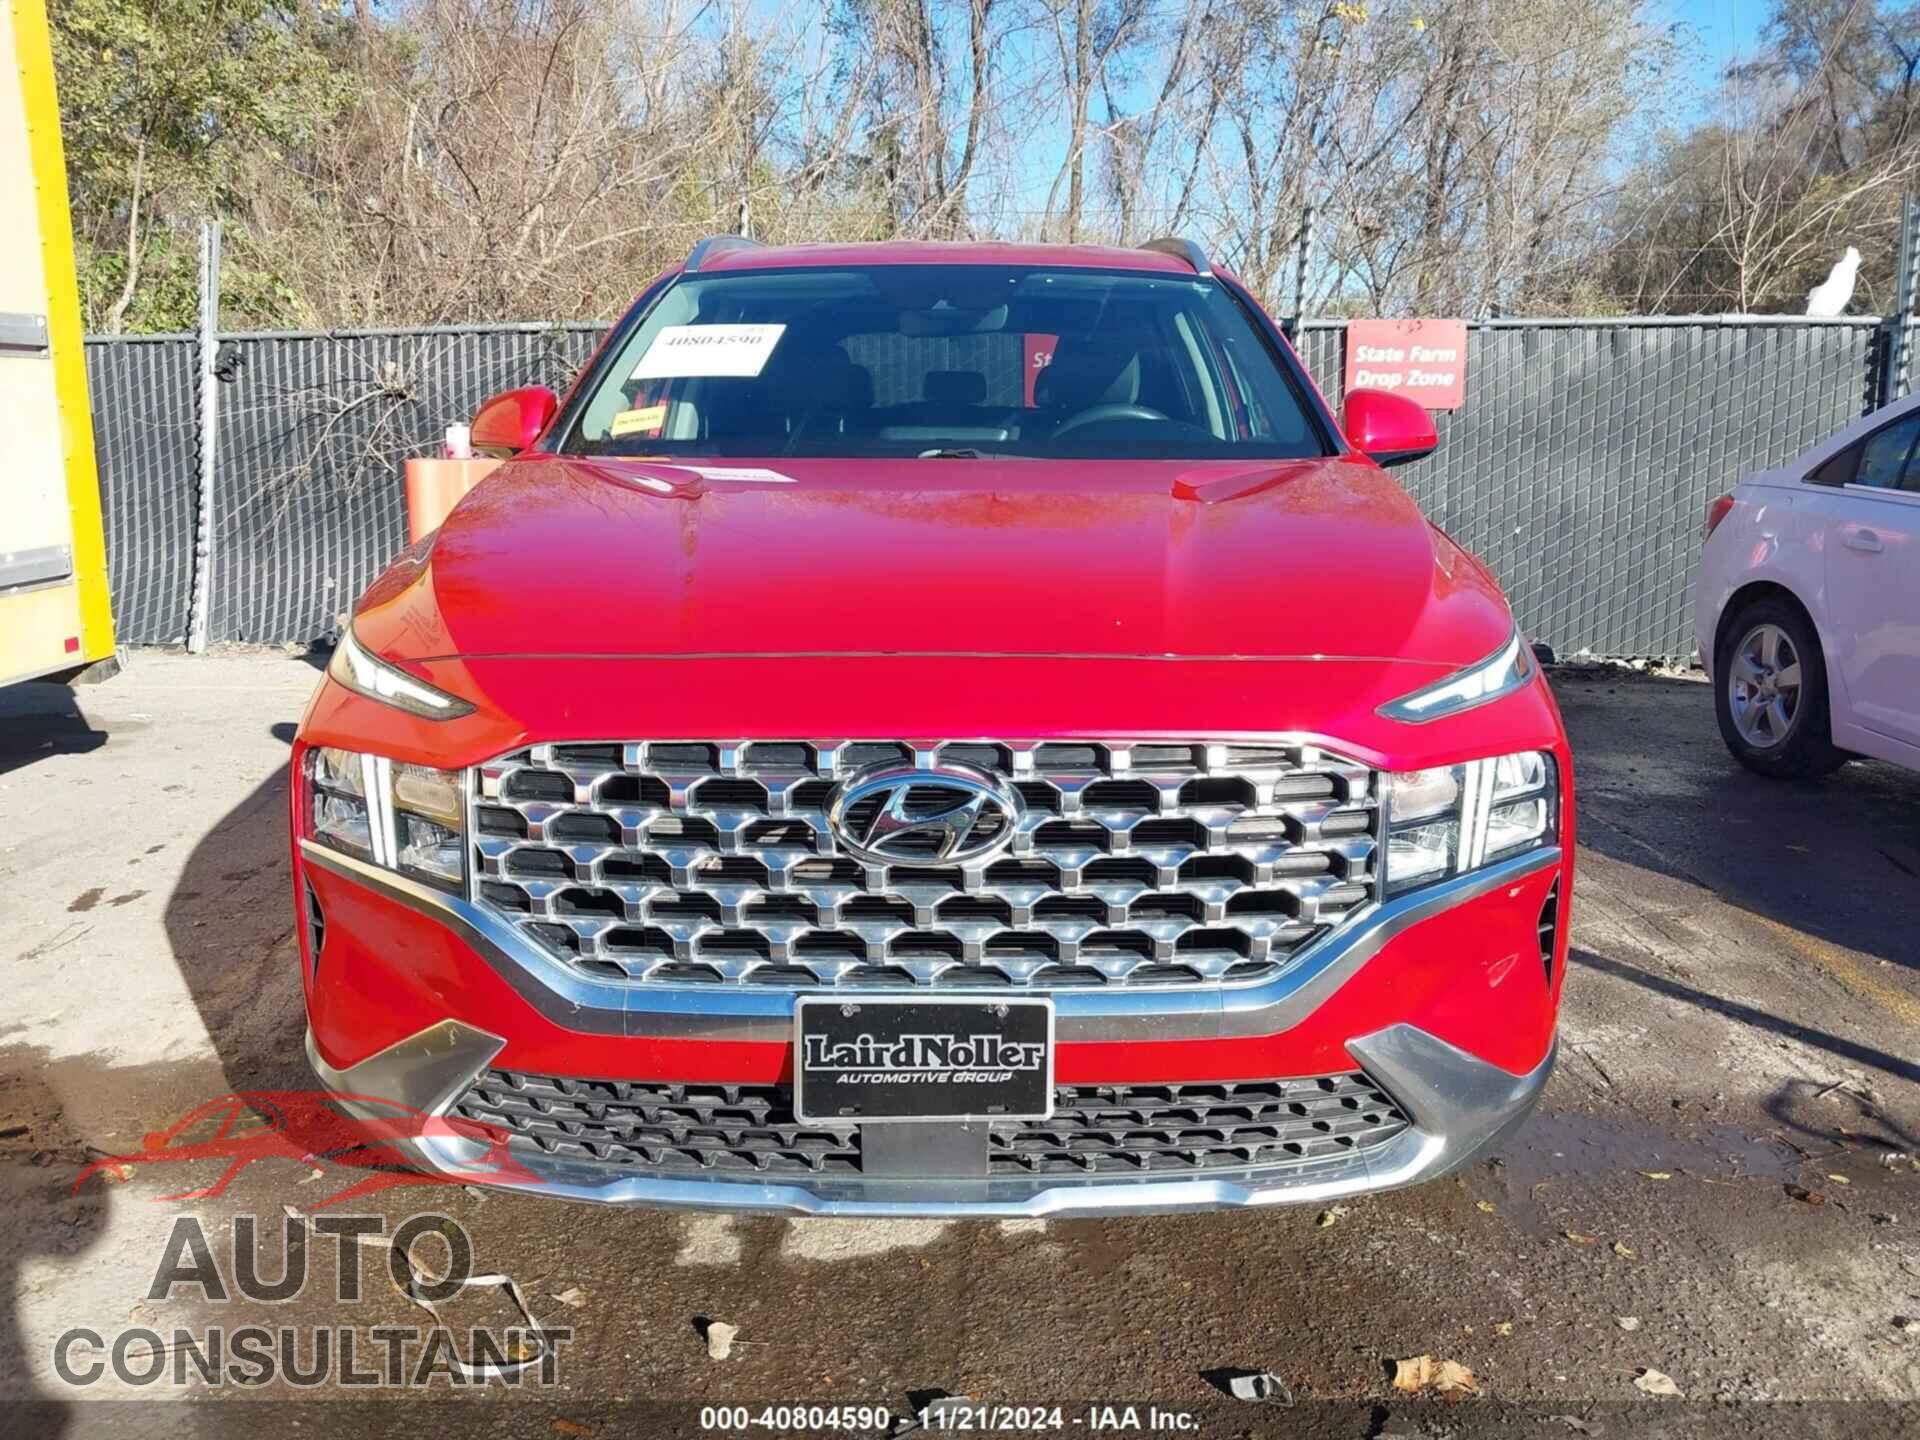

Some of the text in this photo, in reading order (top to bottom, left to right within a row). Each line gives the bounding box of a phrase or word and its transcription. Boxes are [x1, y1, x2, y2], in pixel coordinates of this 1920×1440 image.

[1355, 346, 1456, 362] State Farm
[1354, 370, 1455, 389] Drop Zone
[837, 1071, 1012, 1084] AUTOMOTIVE GROUP
